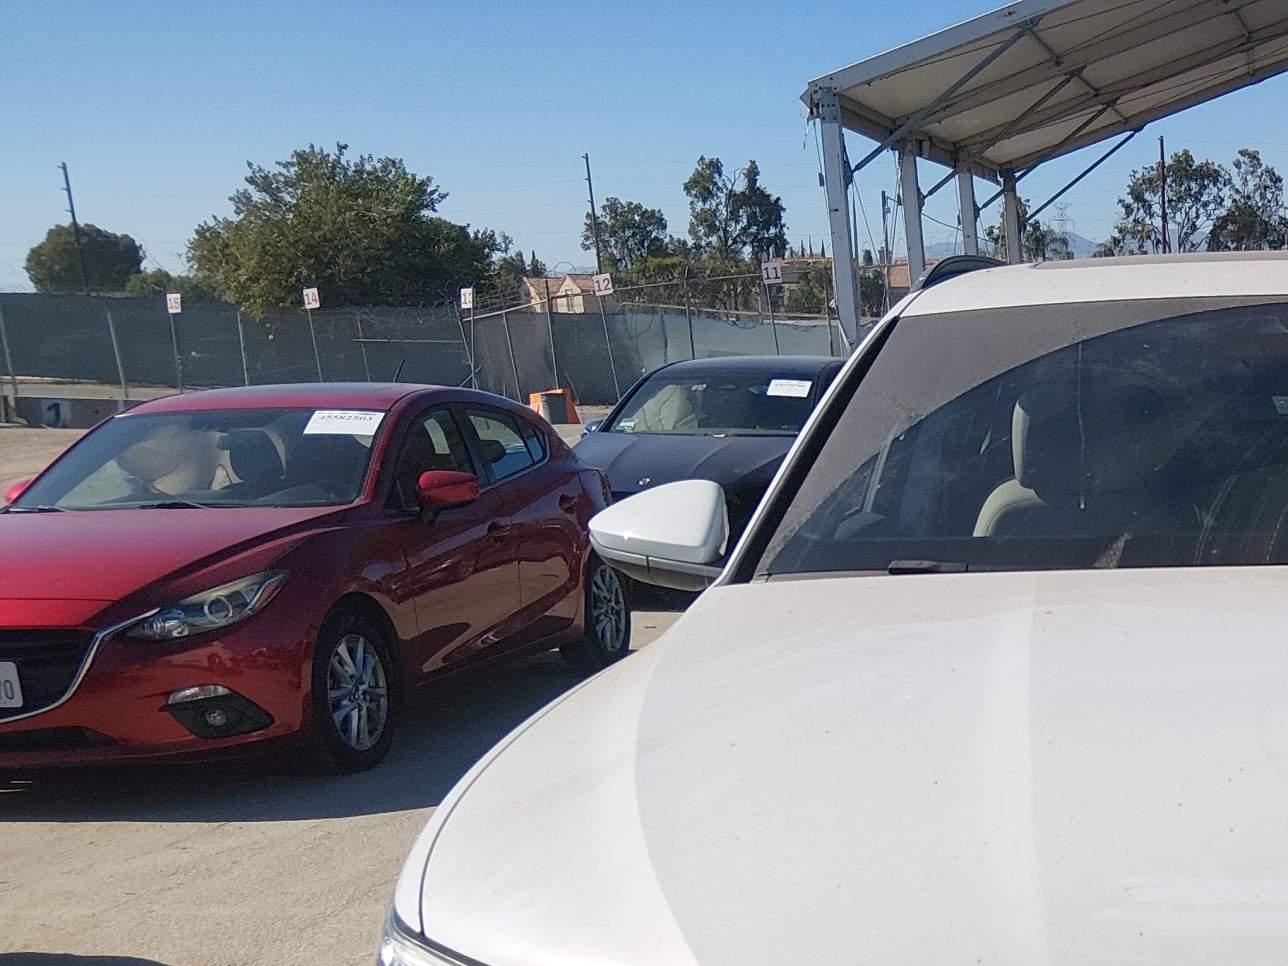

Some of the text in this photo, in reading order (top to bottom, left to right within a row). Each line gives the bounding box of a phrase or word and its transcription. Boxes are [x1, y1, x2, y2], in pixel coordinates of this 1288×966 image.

[763, 267, 781, 280] 11
[594, 278, 611, 292] 12
[168, 297, 180, 310] 15
[304, 292, 318, 305] 14
[0, 679, 15, 700] 0
